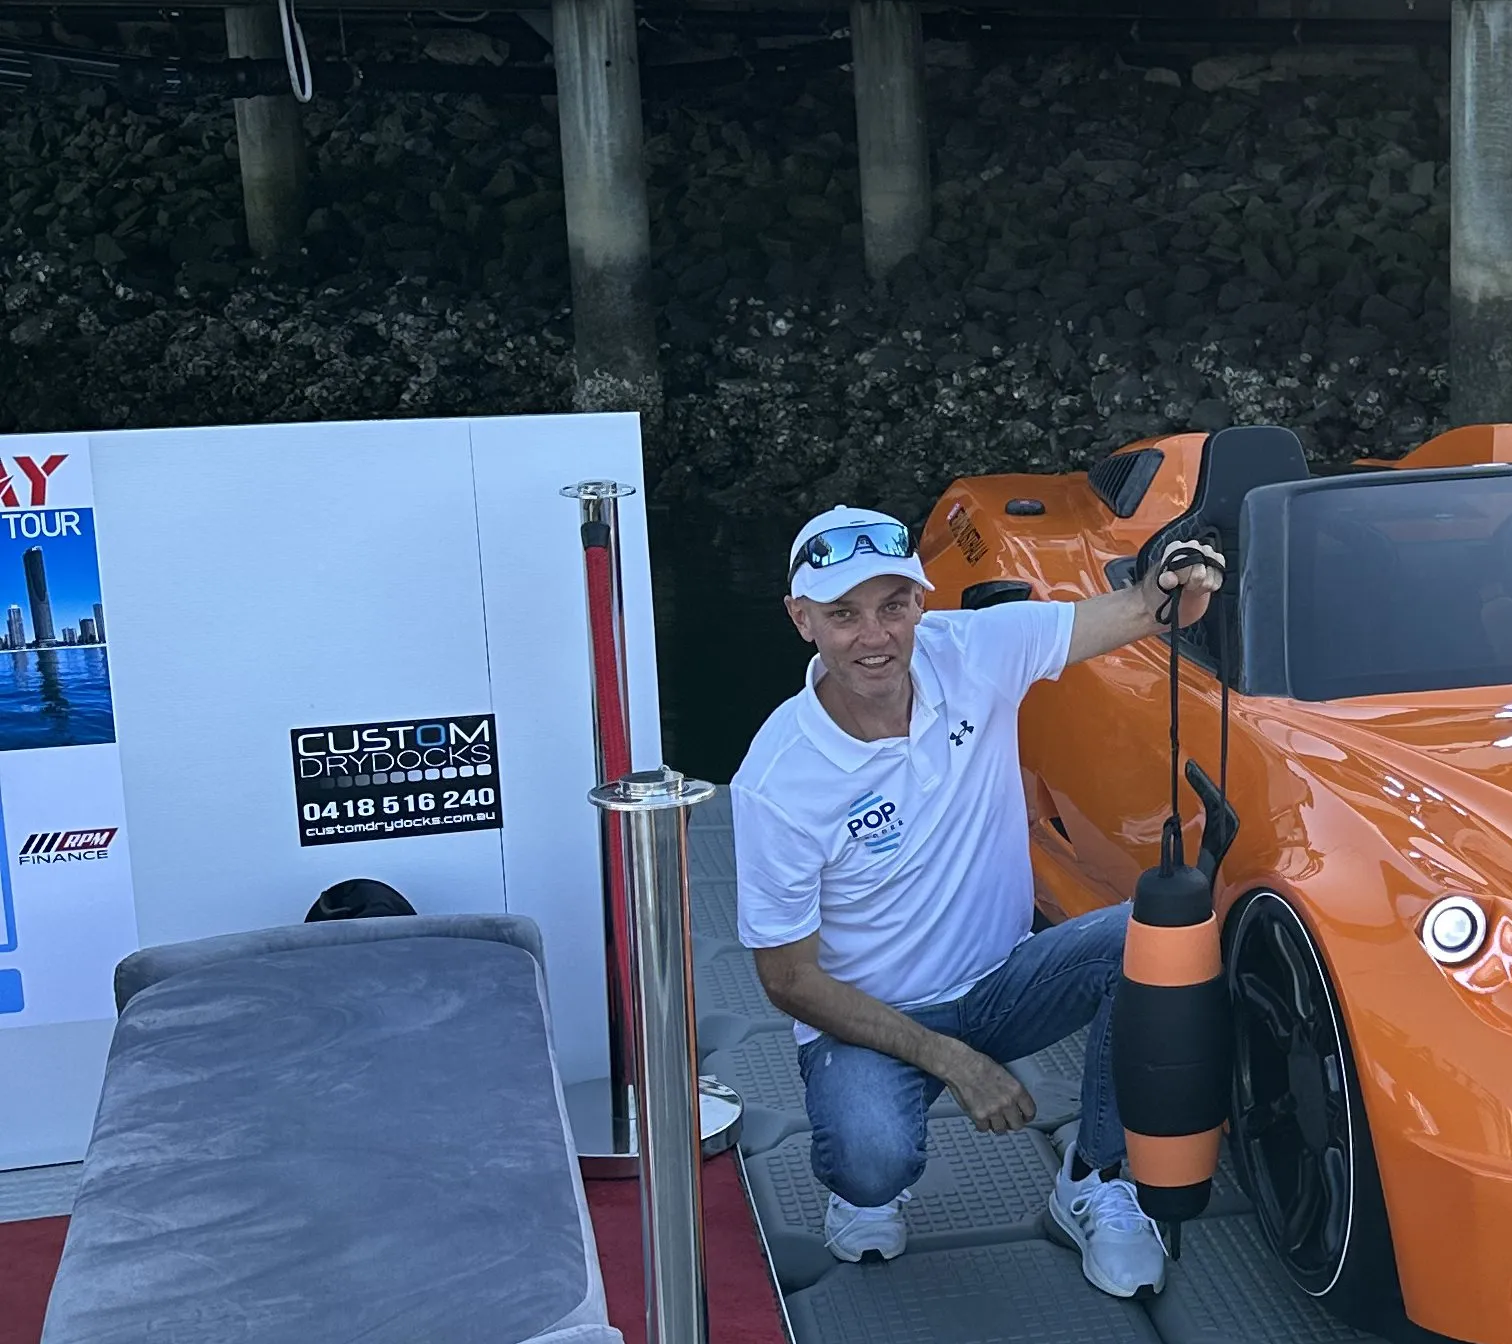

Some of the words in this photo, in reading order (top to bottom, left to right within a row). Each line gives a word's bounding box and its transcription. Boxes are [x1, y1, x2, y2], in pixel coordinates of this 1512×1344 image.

[2, 510, 82, 540] TOUR
[297, 719, 490, 757] CUSTOM
[299, 743, 491, 779] DRYDOCKS
[302, 798, 376, 821] 0418
[382, 792, 436, 815] 516
[443, 787, 495, 810] 240
[847, 801, 896, 838] POP
[305, 810, 496, 837] customdrydocks.com.au
[62, 831, 110, 849] RPM
[18, 849, 109, 866] FINANCE
